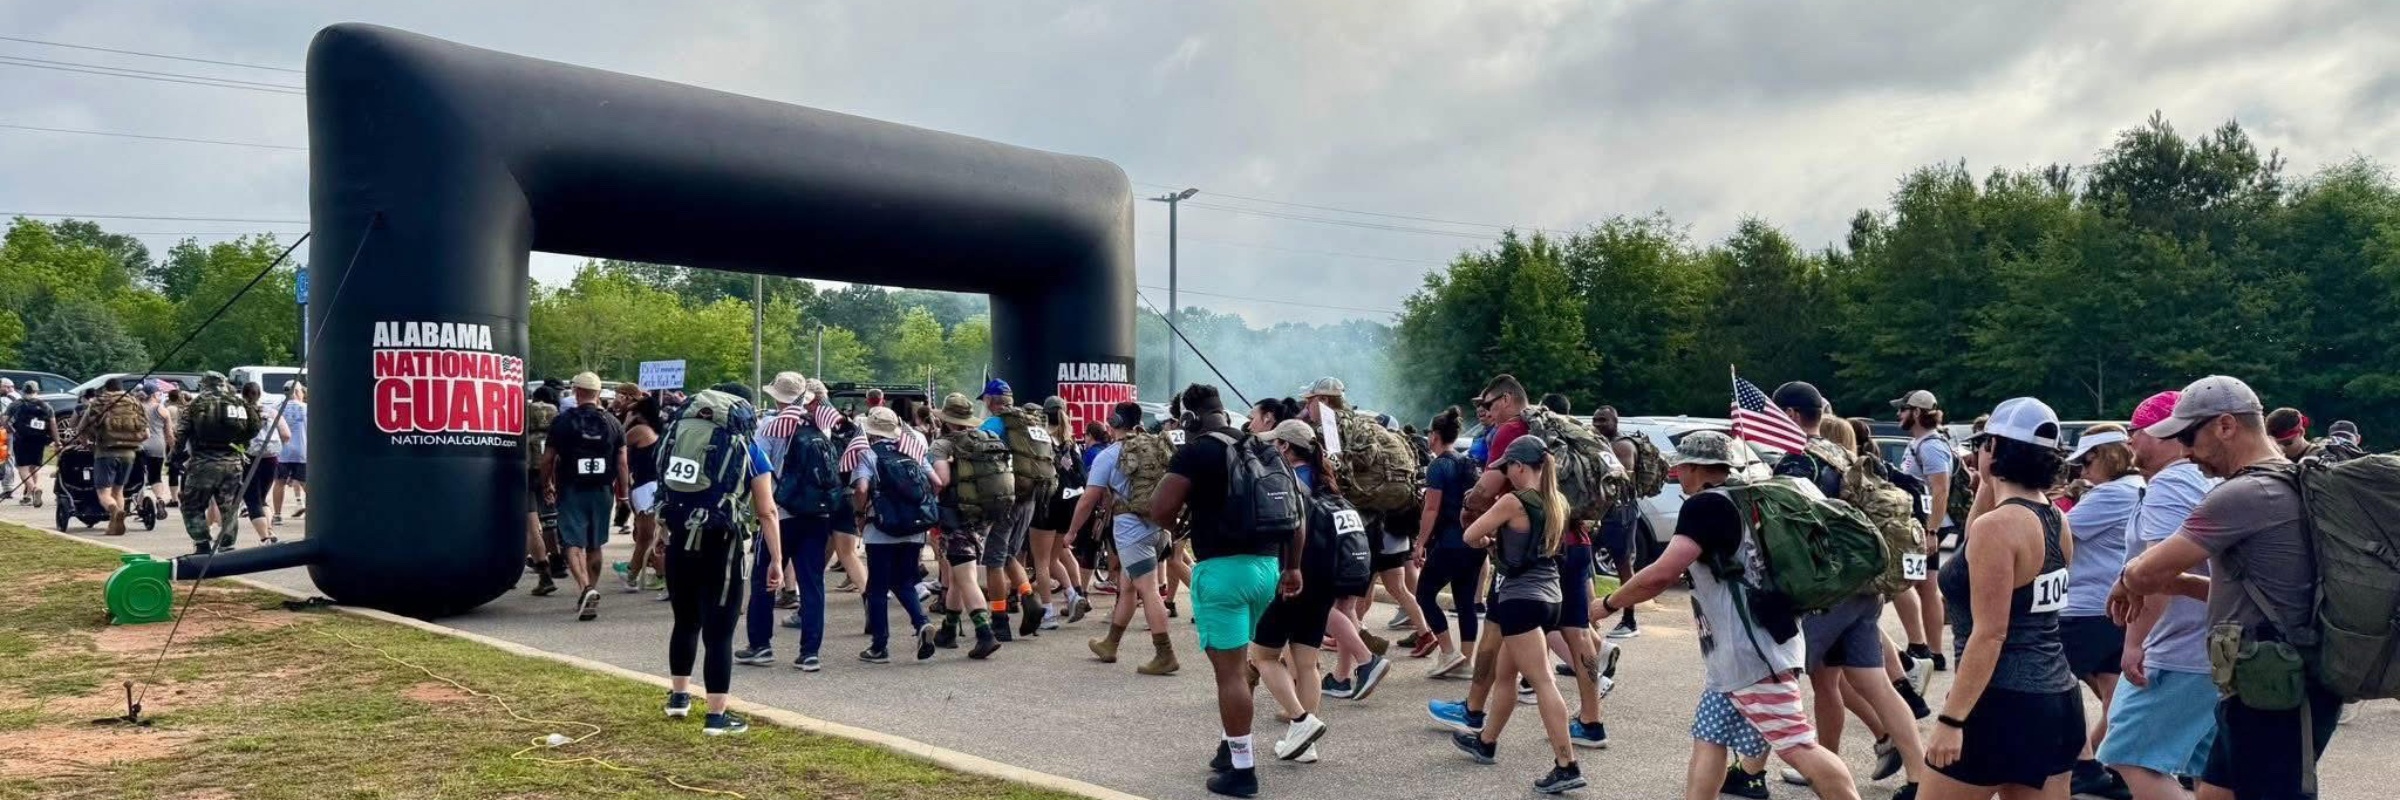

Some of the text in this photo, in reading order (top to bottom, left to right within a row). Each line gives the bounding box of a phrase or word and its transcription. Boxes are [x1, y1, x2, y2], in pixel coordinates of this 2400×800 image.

[372, 321, 493, 350] ALABAMA
[374, 350, 504, 381] NATIONAL
[1057, 362, 1128, 382] ALABAMA
[1058, 383, 1132, 402] NATIONAL
[374, 377, 524, 435] GUARD
[391, 435, 517, 447] NATIONALGUARD.com
[666, 461, 695, 479] 49
[2038, 573, 2068, 605] 104
